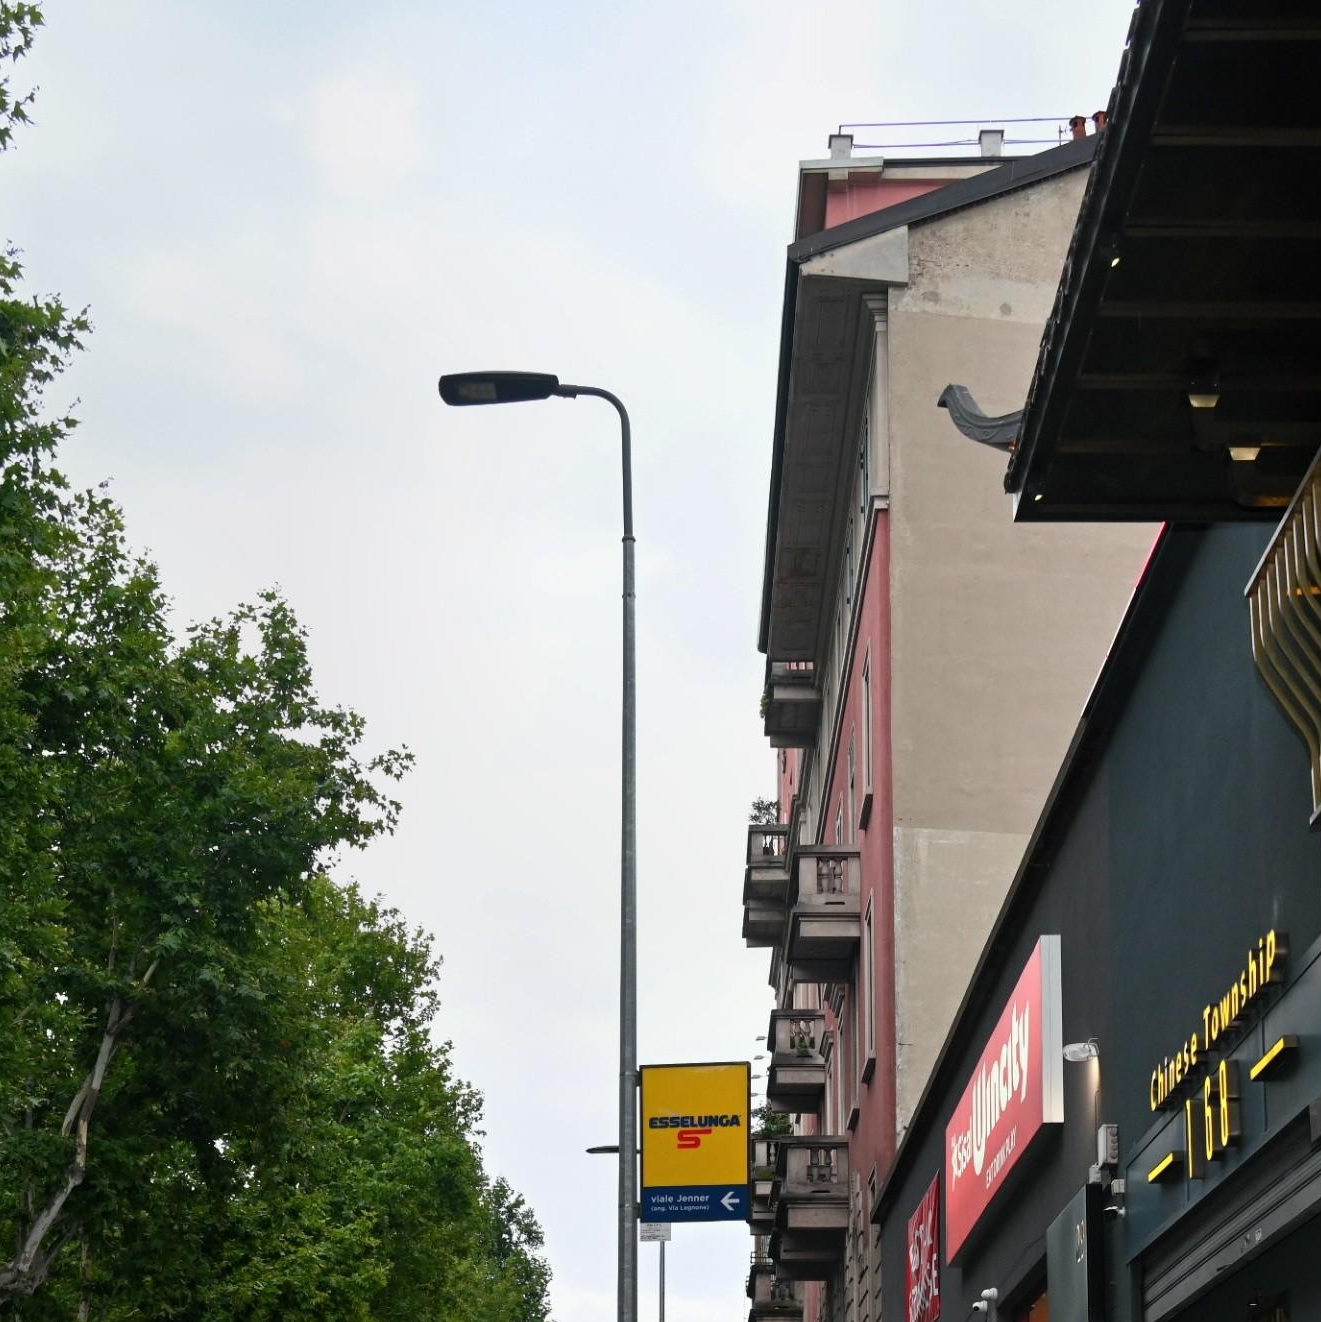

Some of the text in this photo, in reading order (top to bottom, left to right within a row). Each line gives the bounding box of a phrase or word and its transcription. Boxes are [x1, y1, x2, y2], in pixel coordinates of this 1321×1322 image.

[1150, 928, 1277, 1112] Chinese Township
[648, 1115, 740, 1129] ESSELUNGA
[1186, 1058, 1229, 1179] 168
[651, 1194, 710, 1203] viale Jenner
